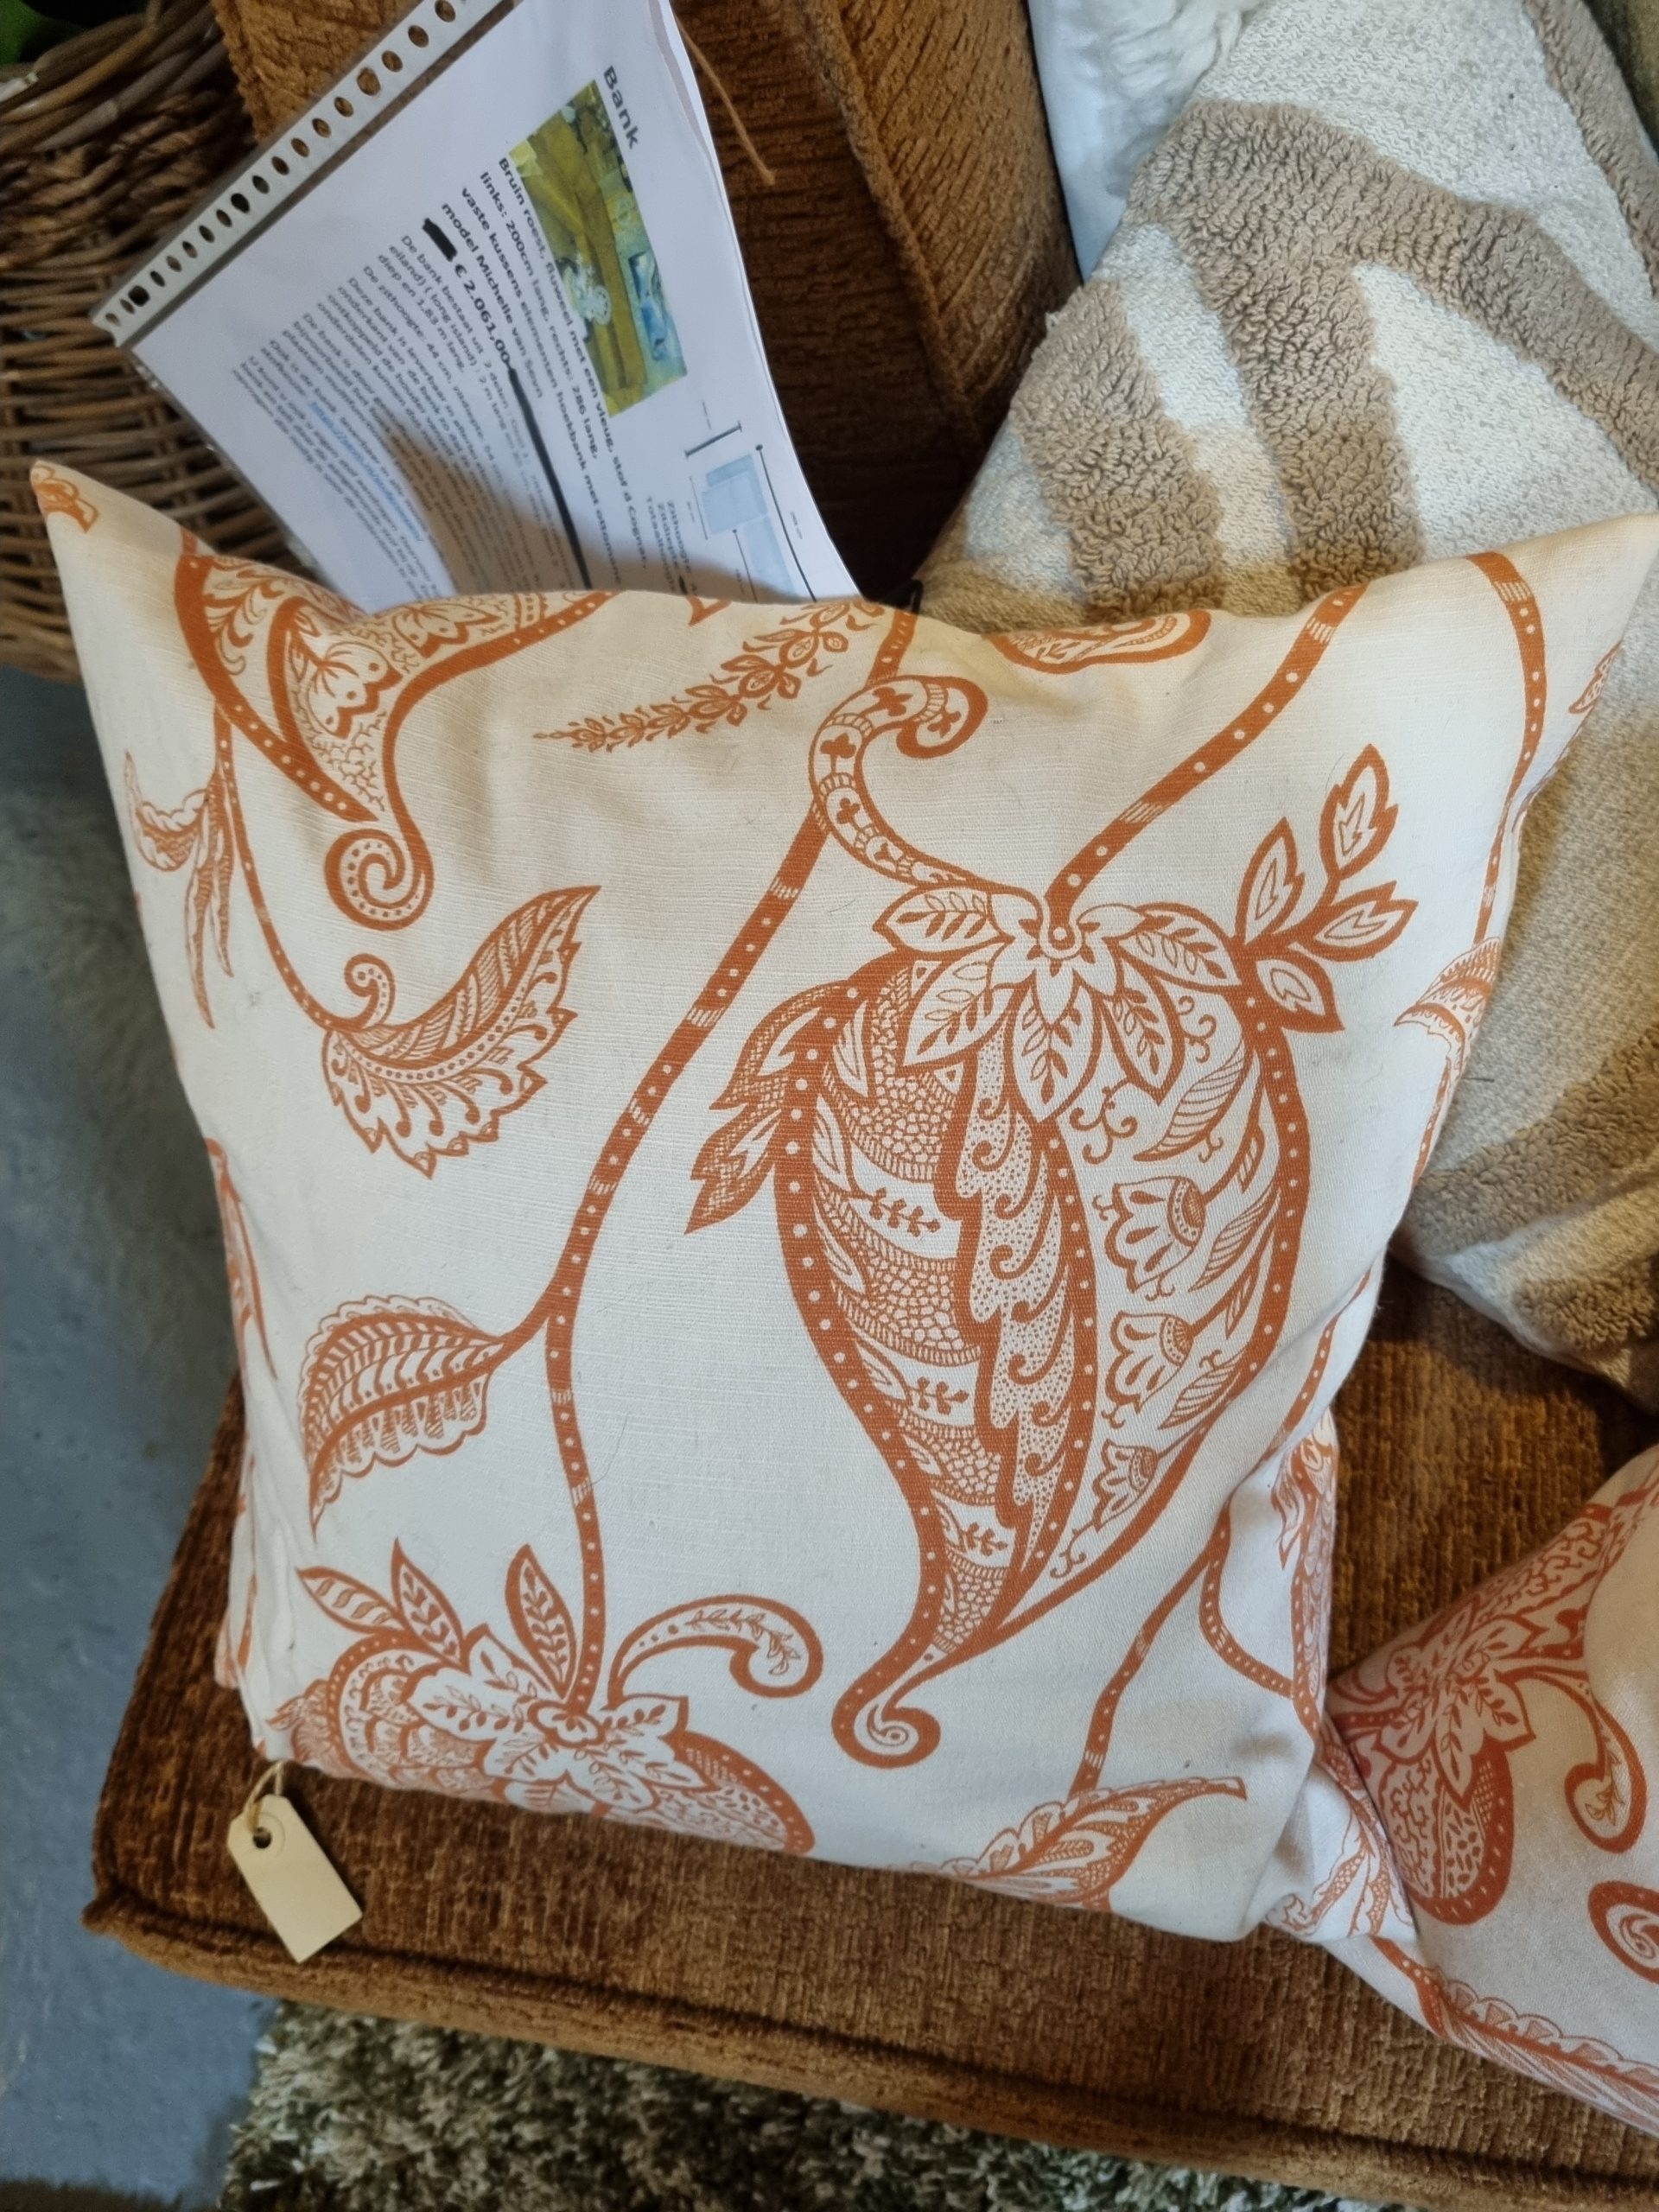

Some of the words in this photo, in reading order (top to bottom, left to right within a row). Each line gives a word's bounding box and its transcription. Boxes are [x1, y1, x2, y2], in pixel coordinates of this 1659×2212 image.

[603, 65, 638, 149] Bank
[441, 202, 479, 252] model
[475, 254, 512, 323] Michelle
[461, 187, 490, 231] vaste
[488, 232, 522, 298] kussens
[480, 171, 507, 217] links:
[505, 219, 533, 276] 200cm
[362, 264, 378, 283] De
[400, 234, 417, 253] De
[416, 253, 442, 284] bank
[442, 284, 473, 334] bestaat
[429, 293, 451, 323] long
[454, 263, 467, 278] €
[498, 156, 524, 205] Bruin
[523, 208, 545, 259] roest,
[569, 330, 586, 363] met
[583, 367, 598, 398] een
[372, 306, 397, 336] bank
